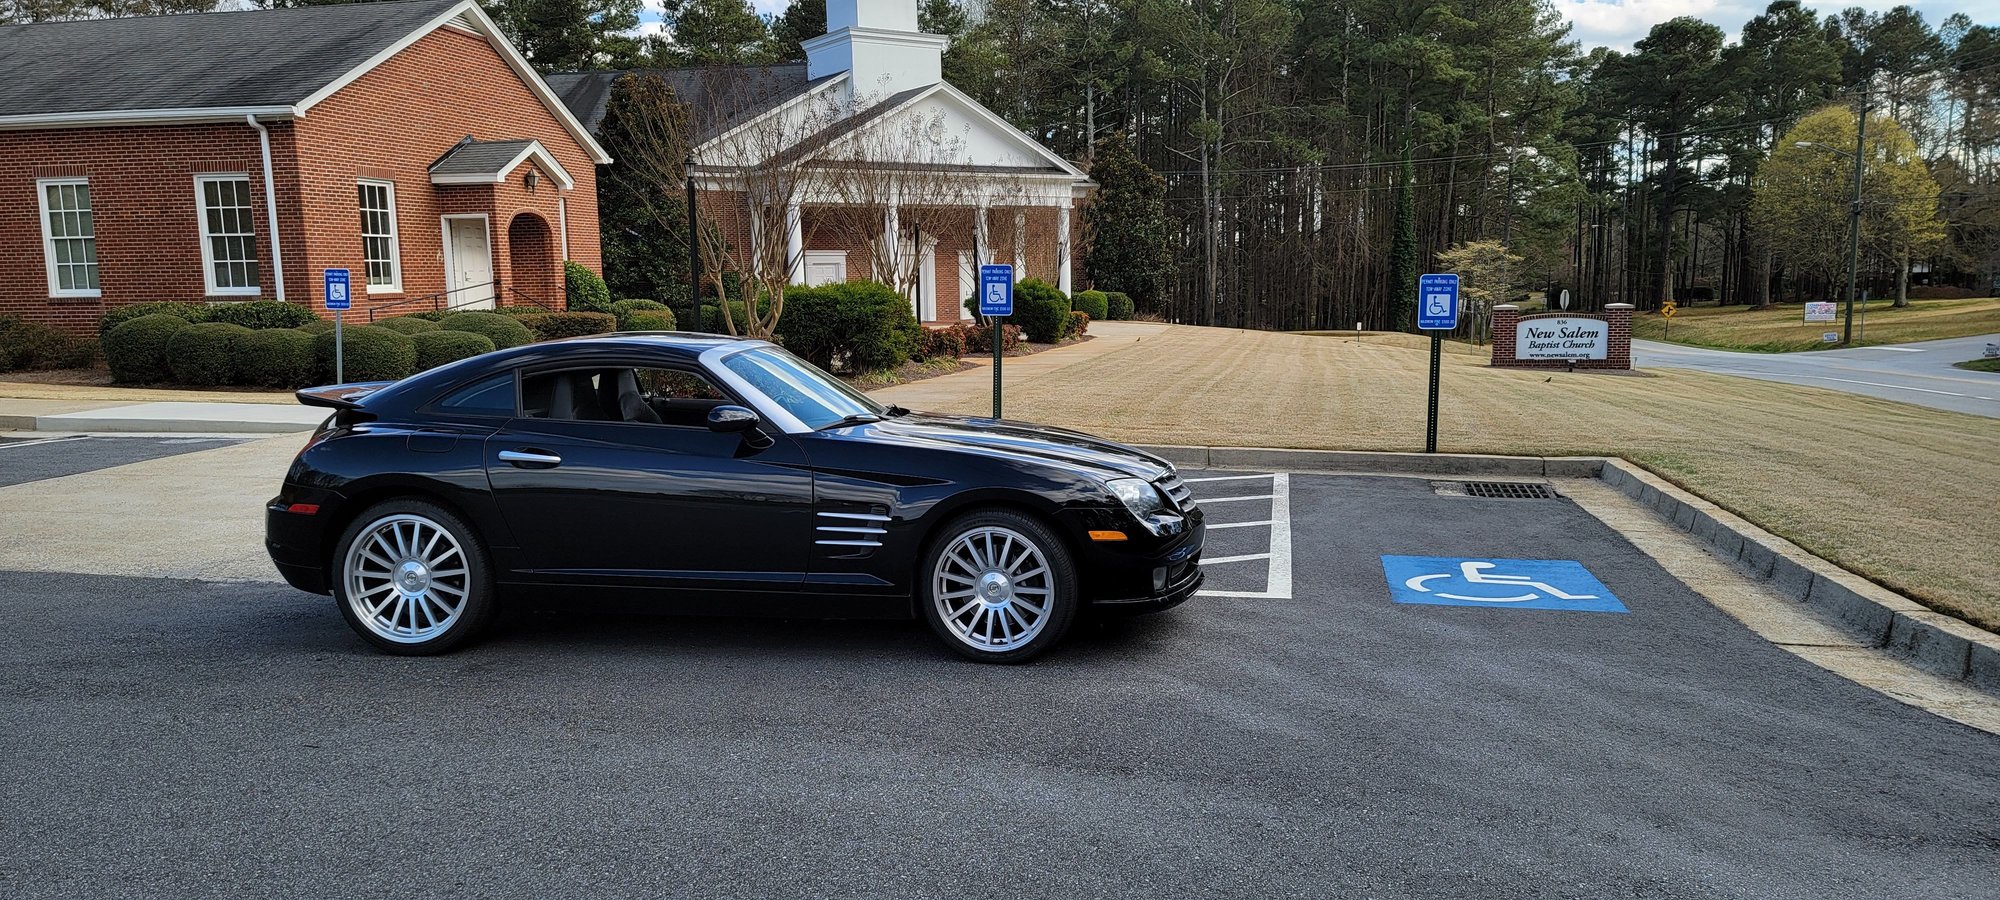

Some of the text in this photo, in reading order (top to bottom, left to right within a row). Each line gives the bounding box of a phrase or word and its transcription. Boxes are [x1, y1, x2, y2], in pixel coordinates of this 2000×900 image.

[1525, 326, 1599, 338] New Salem
[1528, 340, 1595, 351] Baptist Church
